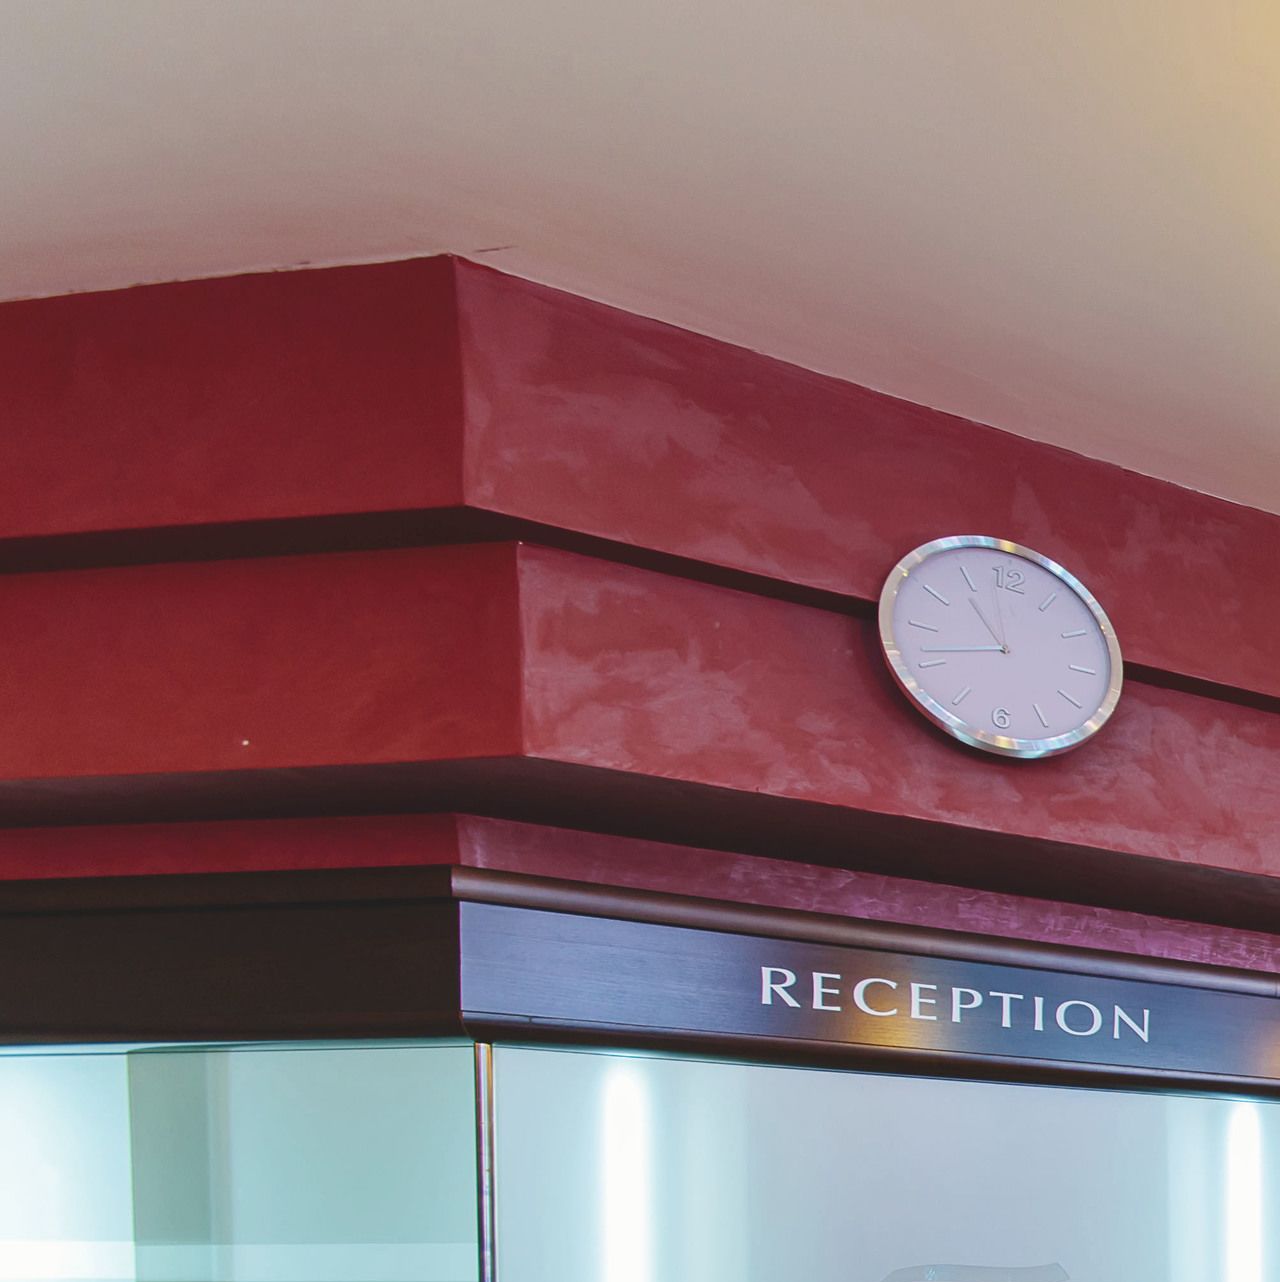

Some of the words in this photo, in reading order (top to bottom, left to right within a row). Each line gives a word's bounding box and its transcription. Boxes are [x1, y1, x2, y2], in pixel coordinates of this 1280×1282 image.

[992, 565, 1025, 595] 12
[991, 707, 1012, 729] 6
[760, 965, 1151, 1044] RECEPTION
